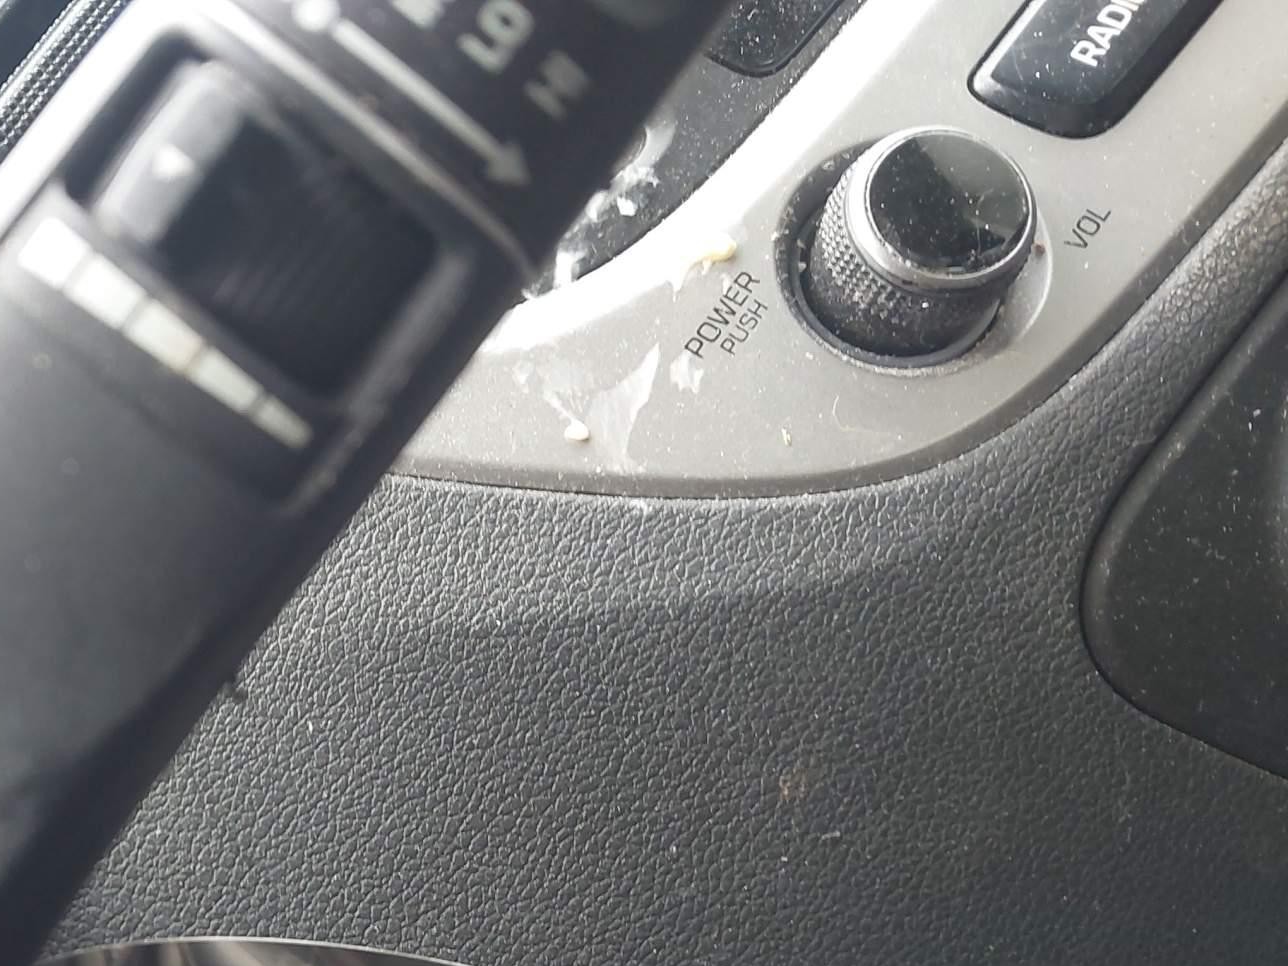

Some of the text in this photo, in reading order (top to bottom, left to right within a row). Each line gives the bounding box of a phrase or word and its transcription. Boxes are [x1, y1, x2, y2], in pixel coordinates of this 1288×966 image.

[456, 0, 534, 74] LO
[1070, 0, 1145, 67] RADI
[1064, 204, 1112, 251] VOL
[684, 271, 761, 358] POWER
[719, 299, 768, 356] PUSH
